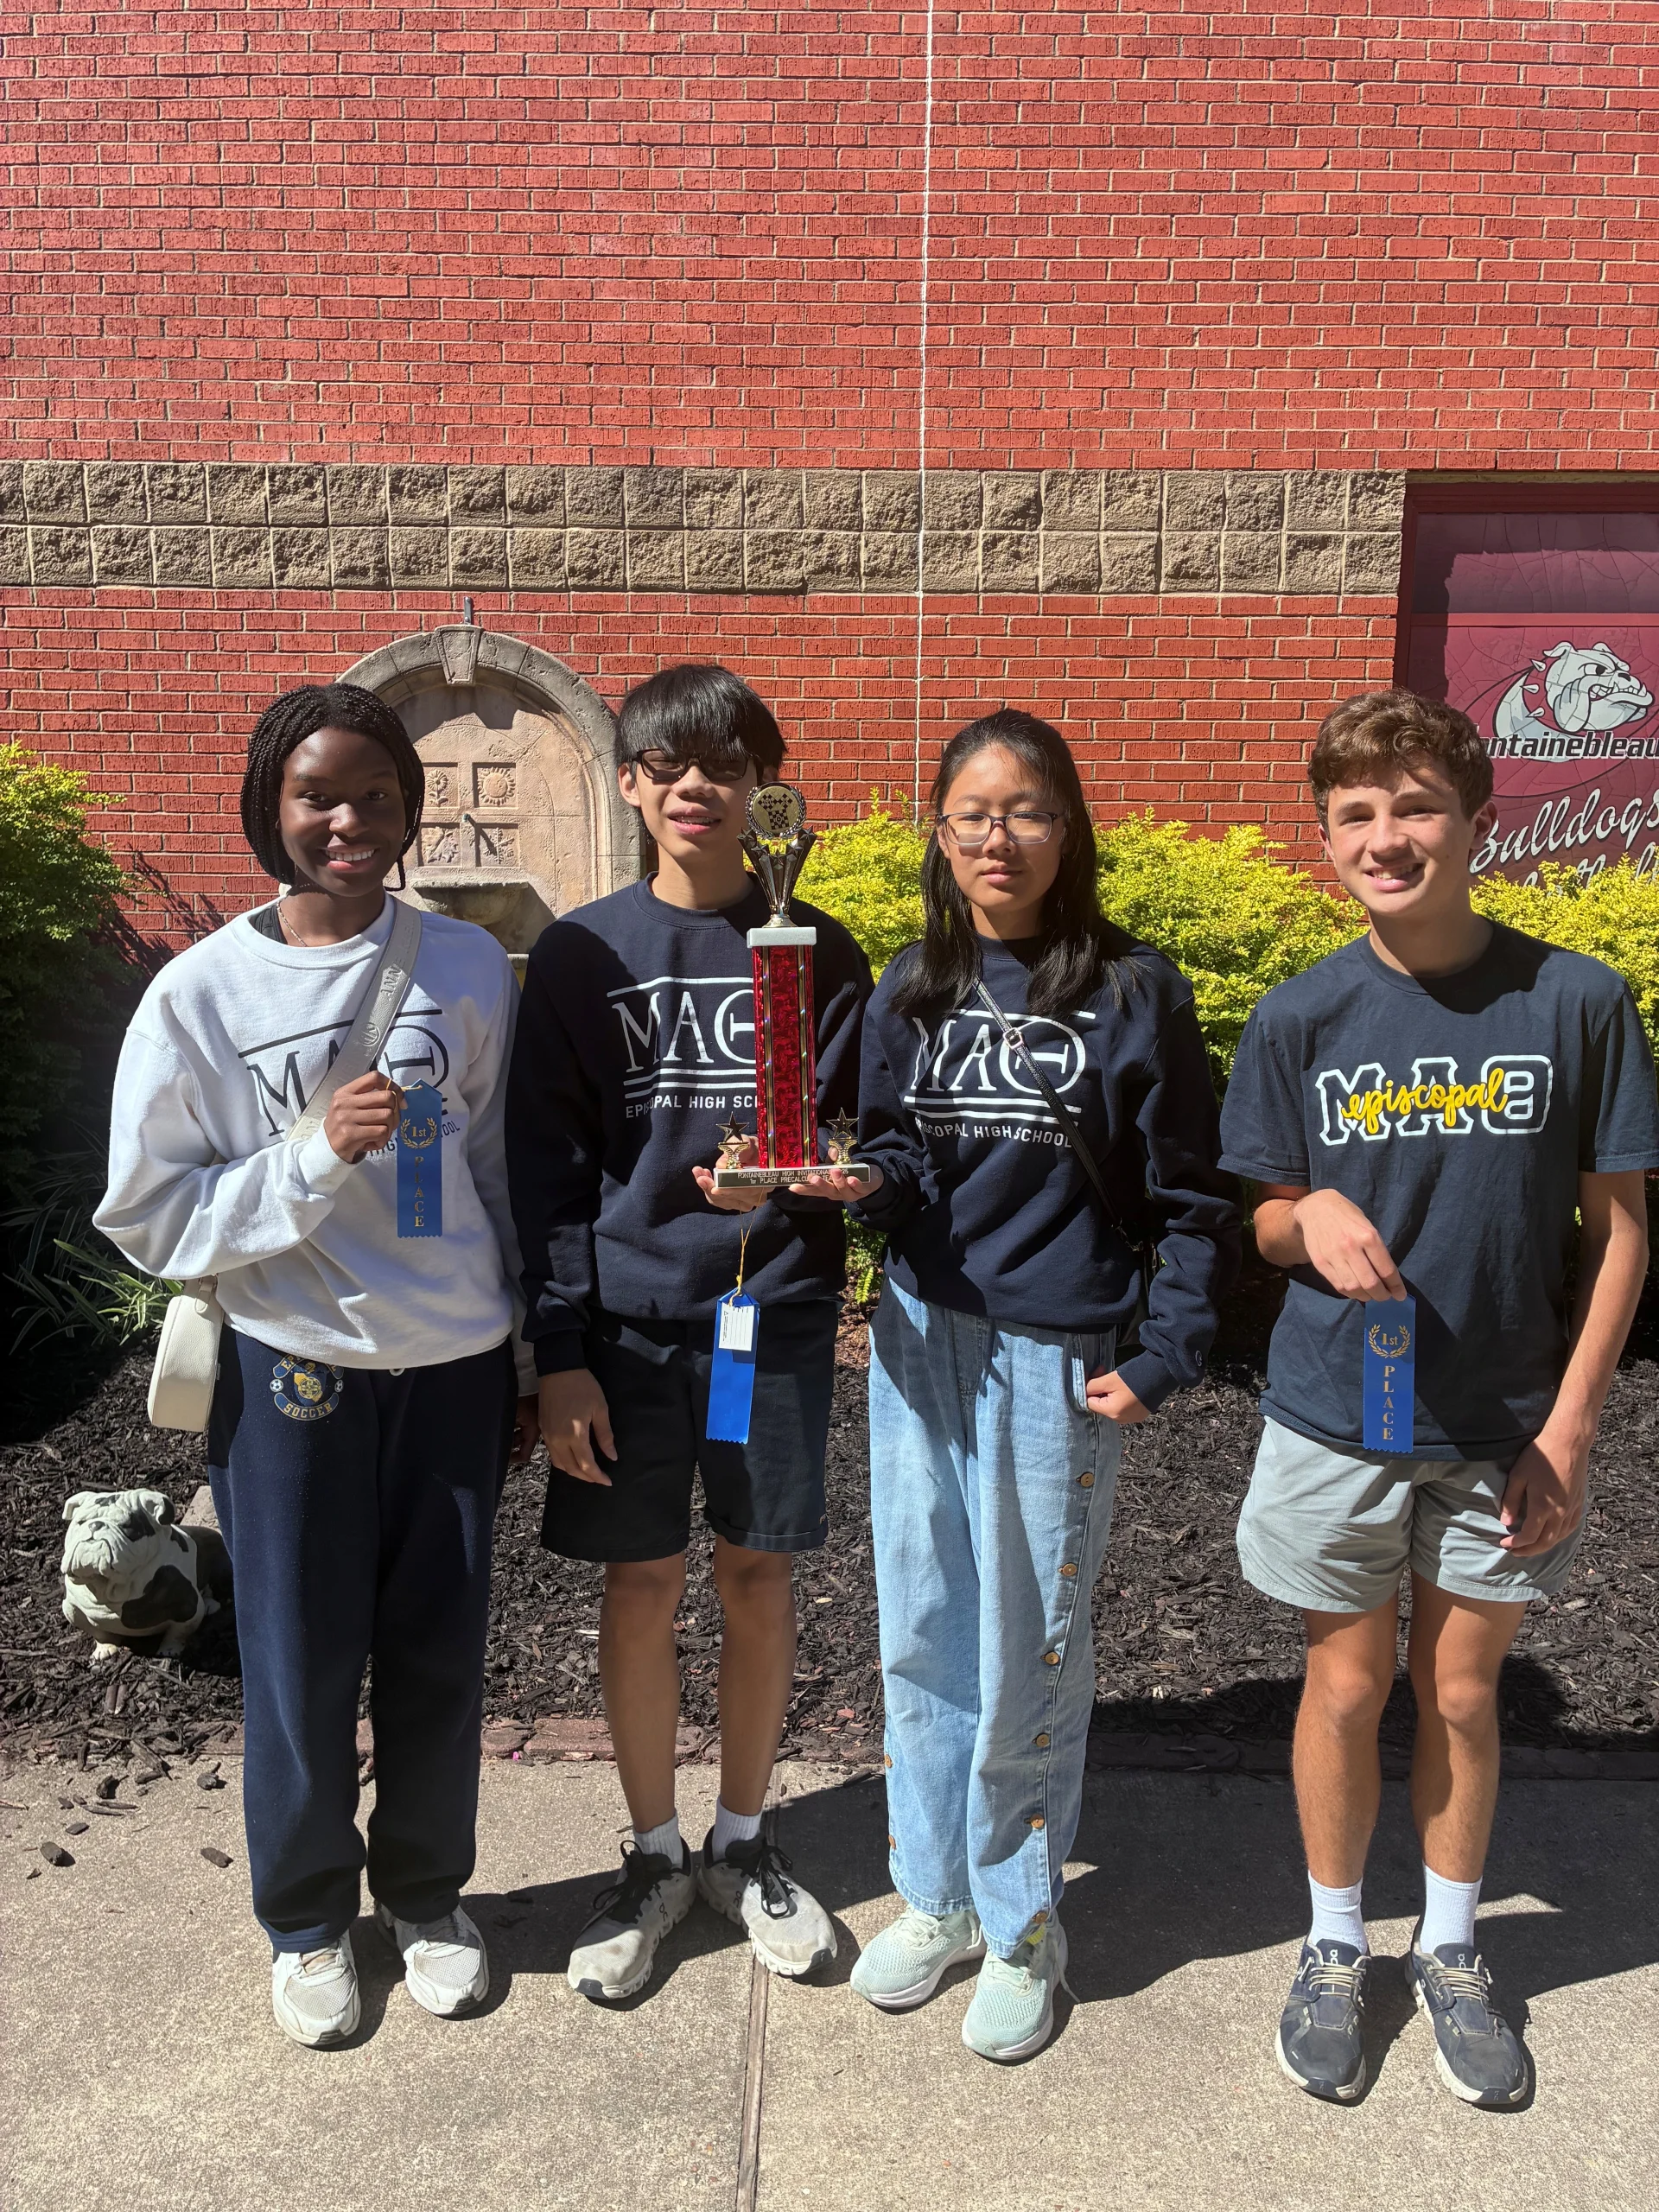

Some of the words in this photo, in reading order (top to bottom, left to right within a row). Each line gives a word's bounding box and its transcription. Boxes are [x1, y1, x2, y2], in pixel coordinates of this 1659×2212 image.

[1474, 723, 1659, 760] ntainebleau
[626, 1095, 682, 1119] EPISOPAL
[689, 1096, 726, 1109] HIGH
[1341, 1068, 1508, 1134] episcopal
[412, 1126, 426, 1137] 1st
[441, 1120, 461, 1137] OOL
[974, 1125, 1012, 1139] HIGH
[1013, 1127, 1072, 1148] SCHOOL
[780, 1174, 809, 1184] PRECALCU
[414, 1156, 424, 1227] PLACE
[1381, 1333, 1399, 1345] 1st
[283, 1402, 333, 1419] SOCCER
[1382, 1365, 1395, 1440] PLACE
